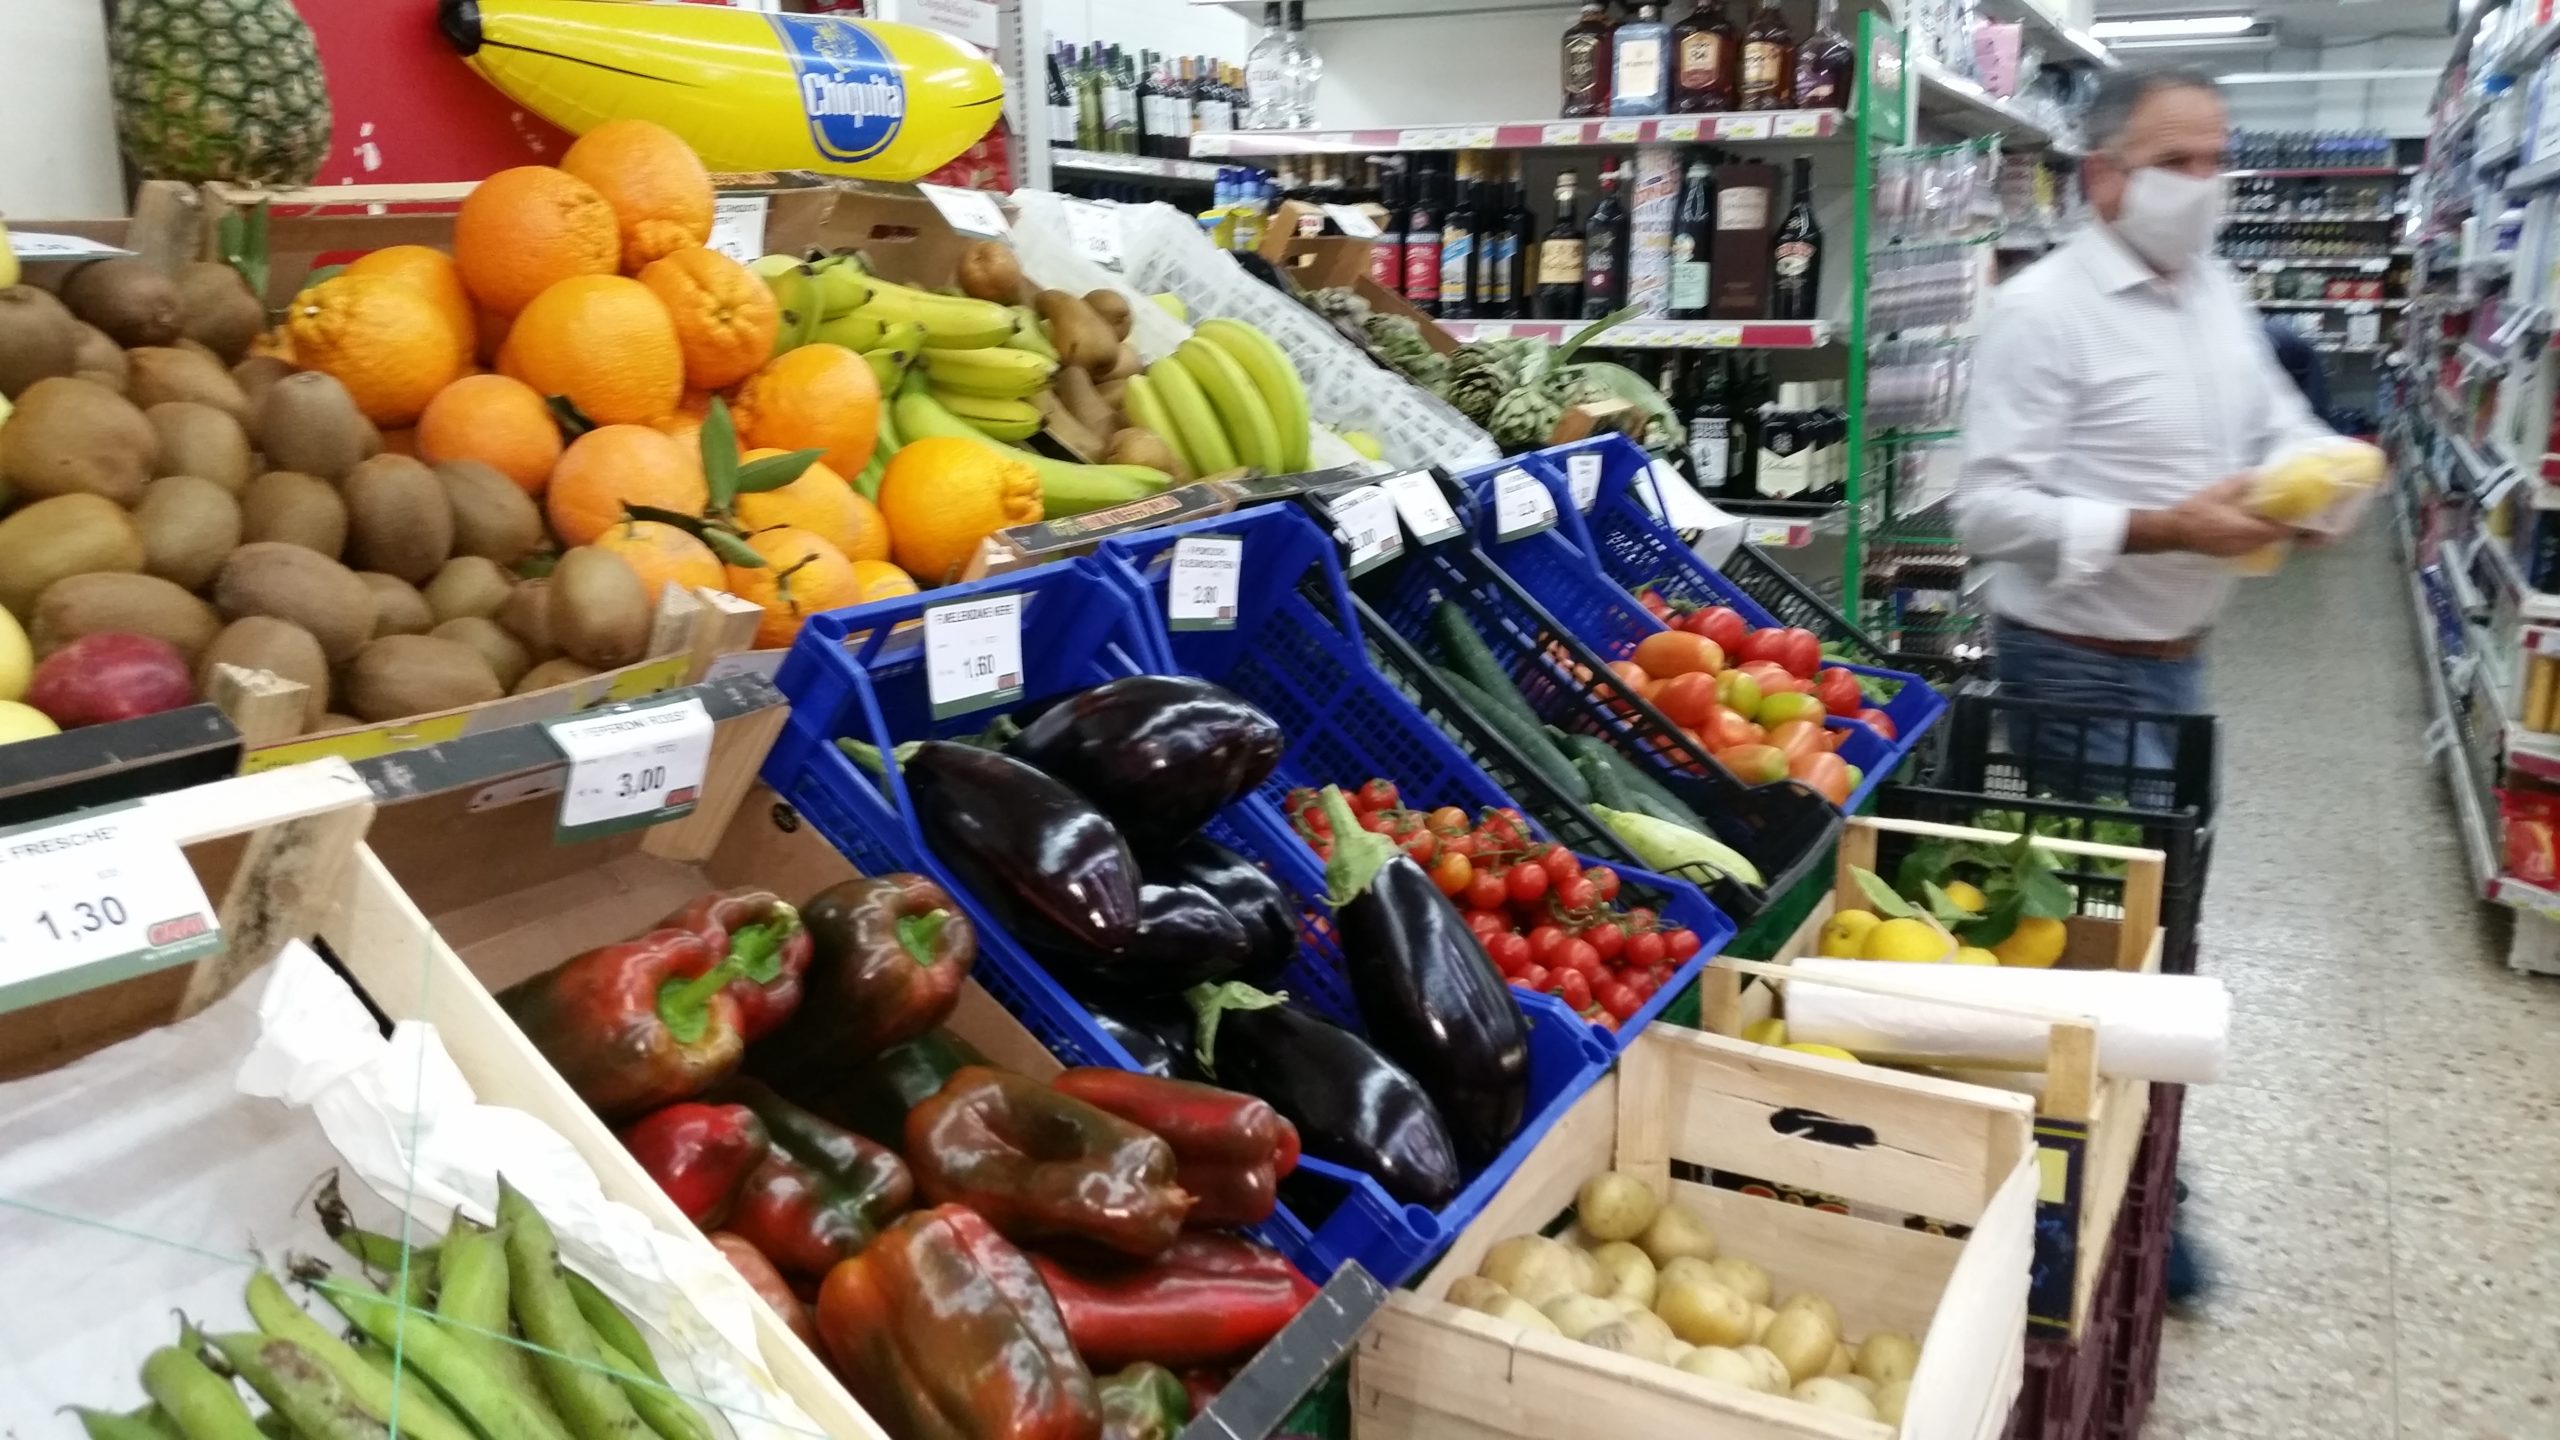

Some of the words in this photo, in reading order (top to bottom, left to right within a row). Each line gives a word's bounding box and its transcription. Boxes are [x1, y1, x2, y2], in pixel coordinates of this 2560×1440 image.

[802, 72, 903, 128] Chiquita
[616, 764, 667, 799] 3,00
[10, 825, 119, 858] FRESCHE
[37, 896, 127, 942] 1,30
